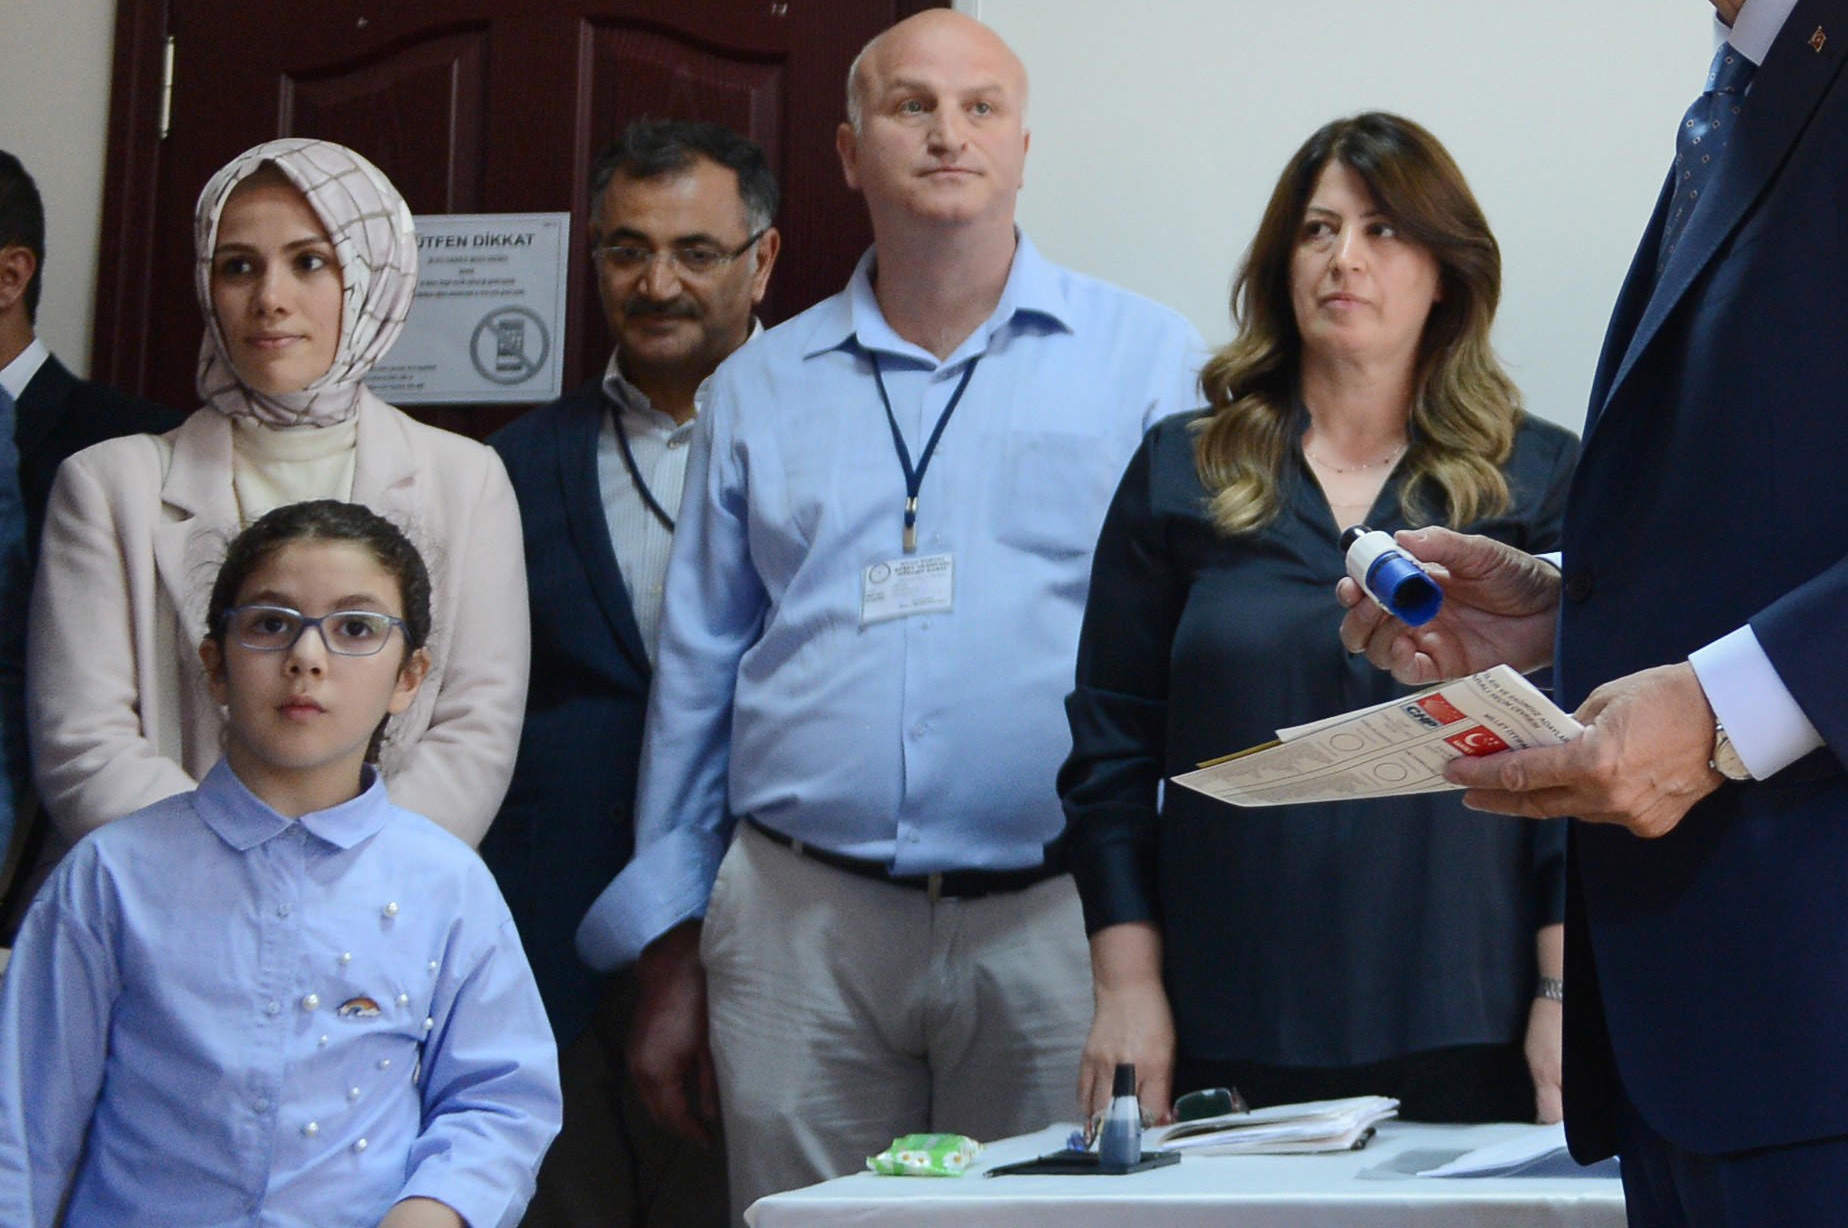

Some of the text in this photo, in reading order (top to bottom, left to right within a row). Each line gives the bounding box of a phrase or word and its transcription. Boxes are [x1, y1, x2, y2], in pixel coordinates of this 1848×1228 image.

[416, 231, 535, 248] ÜTFEN DİKKAT
[1405, 705, 1439, 727] CHP
